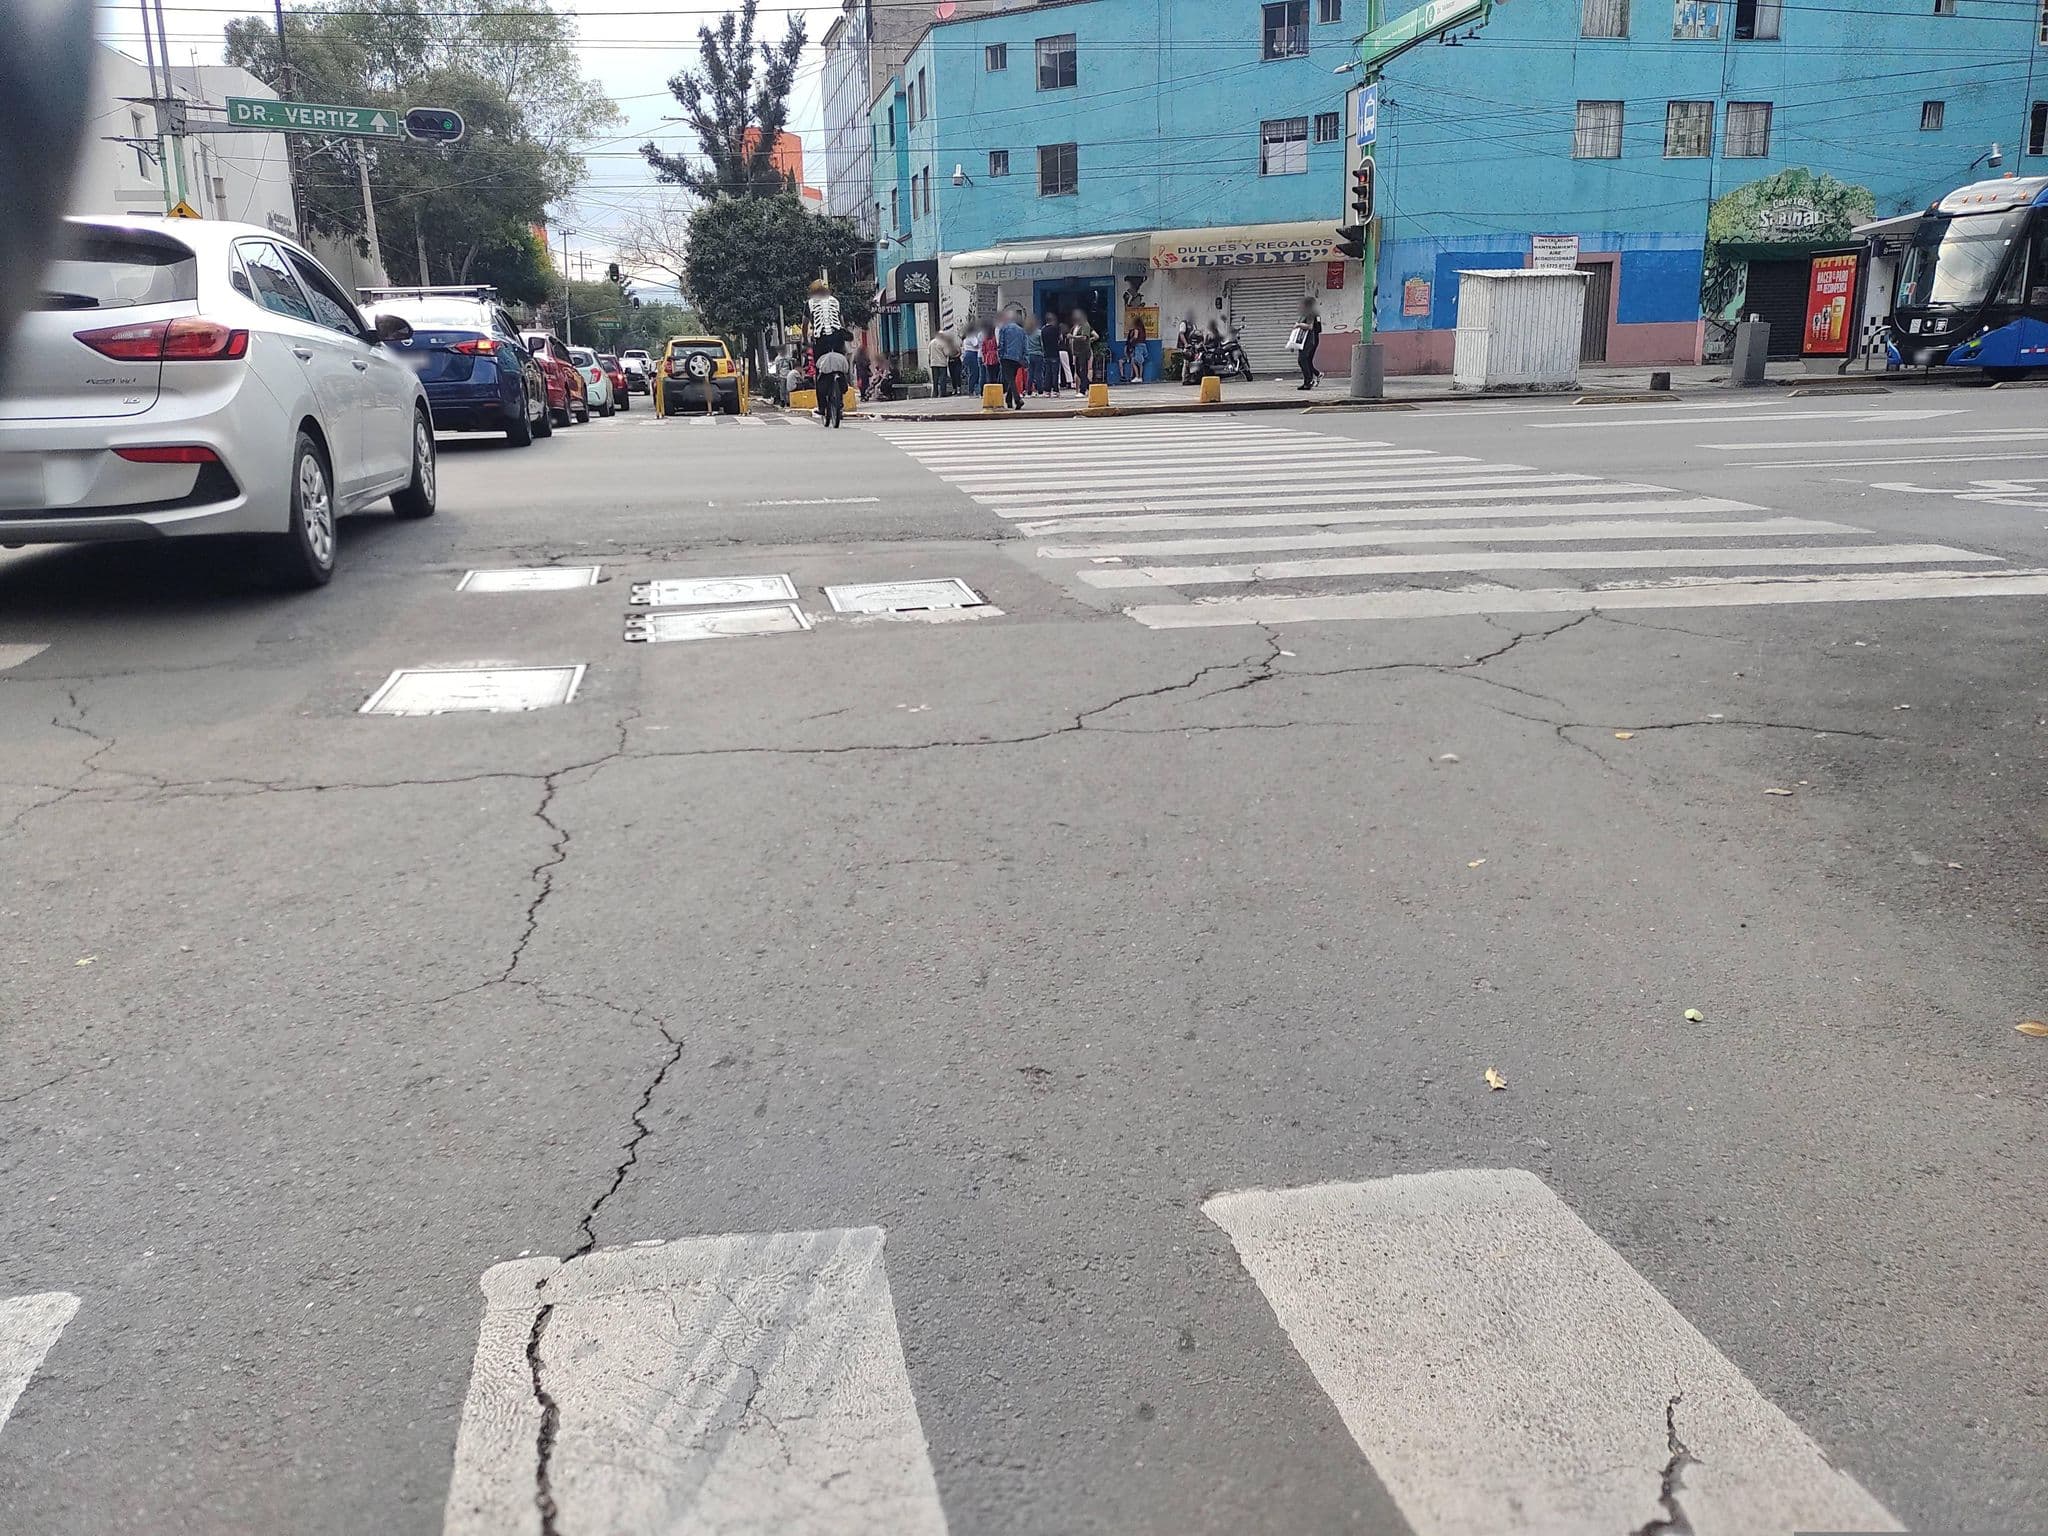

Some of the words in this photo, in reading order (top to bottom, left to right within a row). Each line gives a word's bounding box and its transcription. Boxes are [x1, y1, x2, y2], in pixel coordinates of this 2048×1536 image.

[237, 103, 274, 122] DR.
[285, 107, 360, 128] VERTIZ
[1177, 243, 1237, 254] DULCES
[1239, 241, 1250, 251] Y
[1256, 238, 1333, 250] REGALOS
